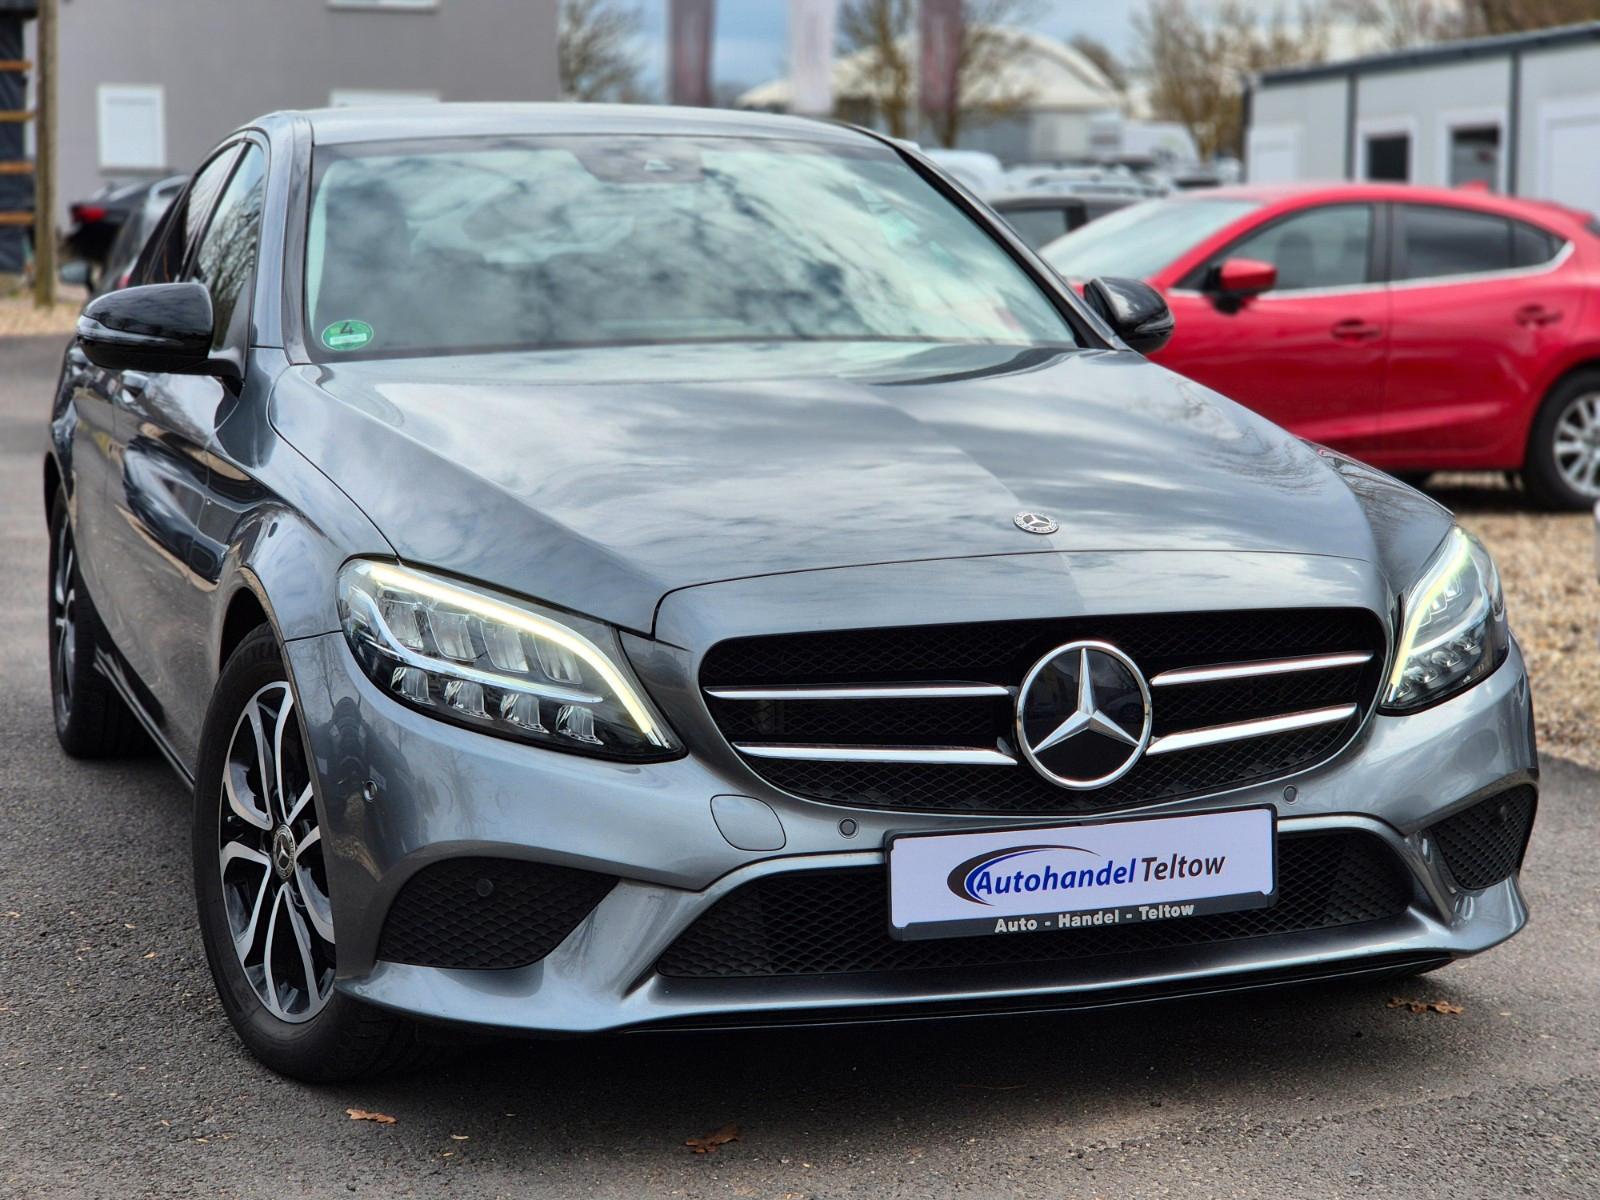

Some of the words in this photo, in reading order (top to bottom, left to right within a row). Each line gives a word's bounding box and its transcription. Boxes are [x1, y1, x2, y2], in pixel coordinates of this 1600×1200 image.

[340, 321, 353, 335] 4
[976, 857, 1137, 895] Autohandel
[1141, 853, 1226, 883] Teltow
[994, 917, 1038, 933] Auto
[1058, 909, 1120, 929] Handel
[1138, 904, 1195, 921] Teltow
